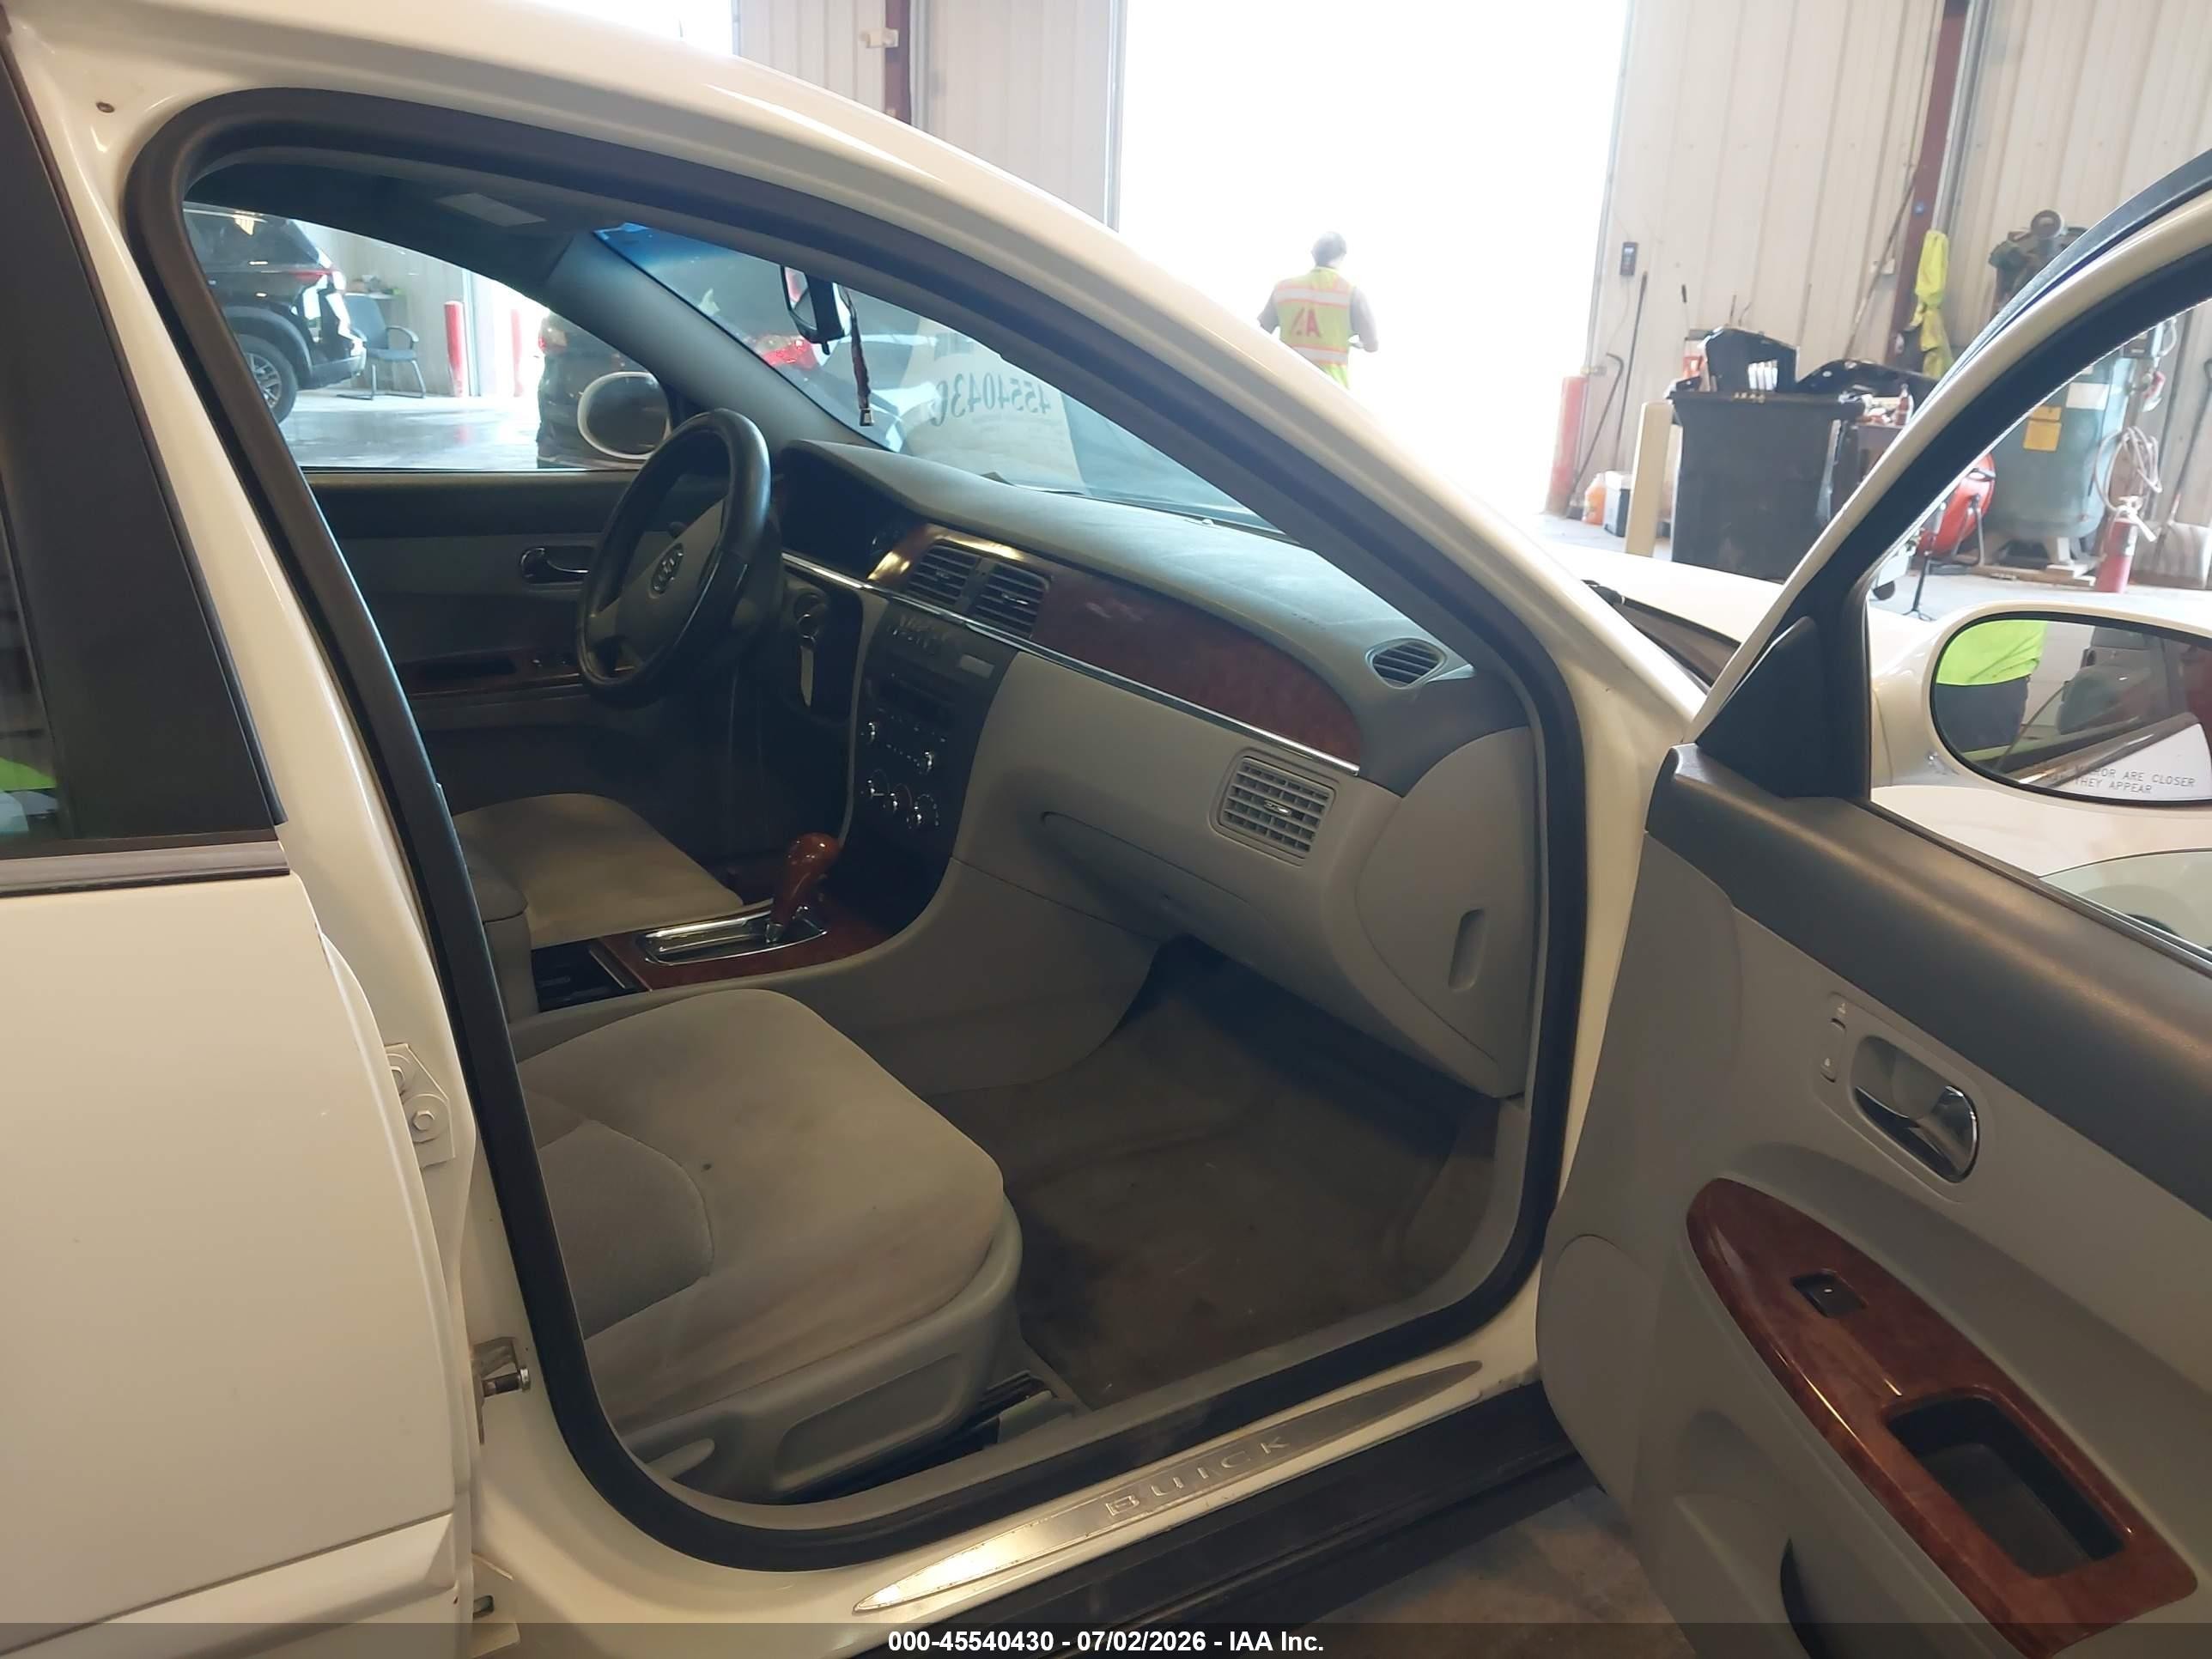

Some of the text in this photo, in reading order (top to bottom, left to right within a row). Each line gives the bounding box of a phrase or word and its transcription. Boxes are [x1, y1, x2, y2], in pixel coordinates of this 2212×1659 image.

[2122, 772, 2145, 782] ARE
[2151, 774, 2197, 787] CLOSER
[2109, 781, 2153, 794] APPEAR
[1105, 1437, 1288, 1516] BUICK
